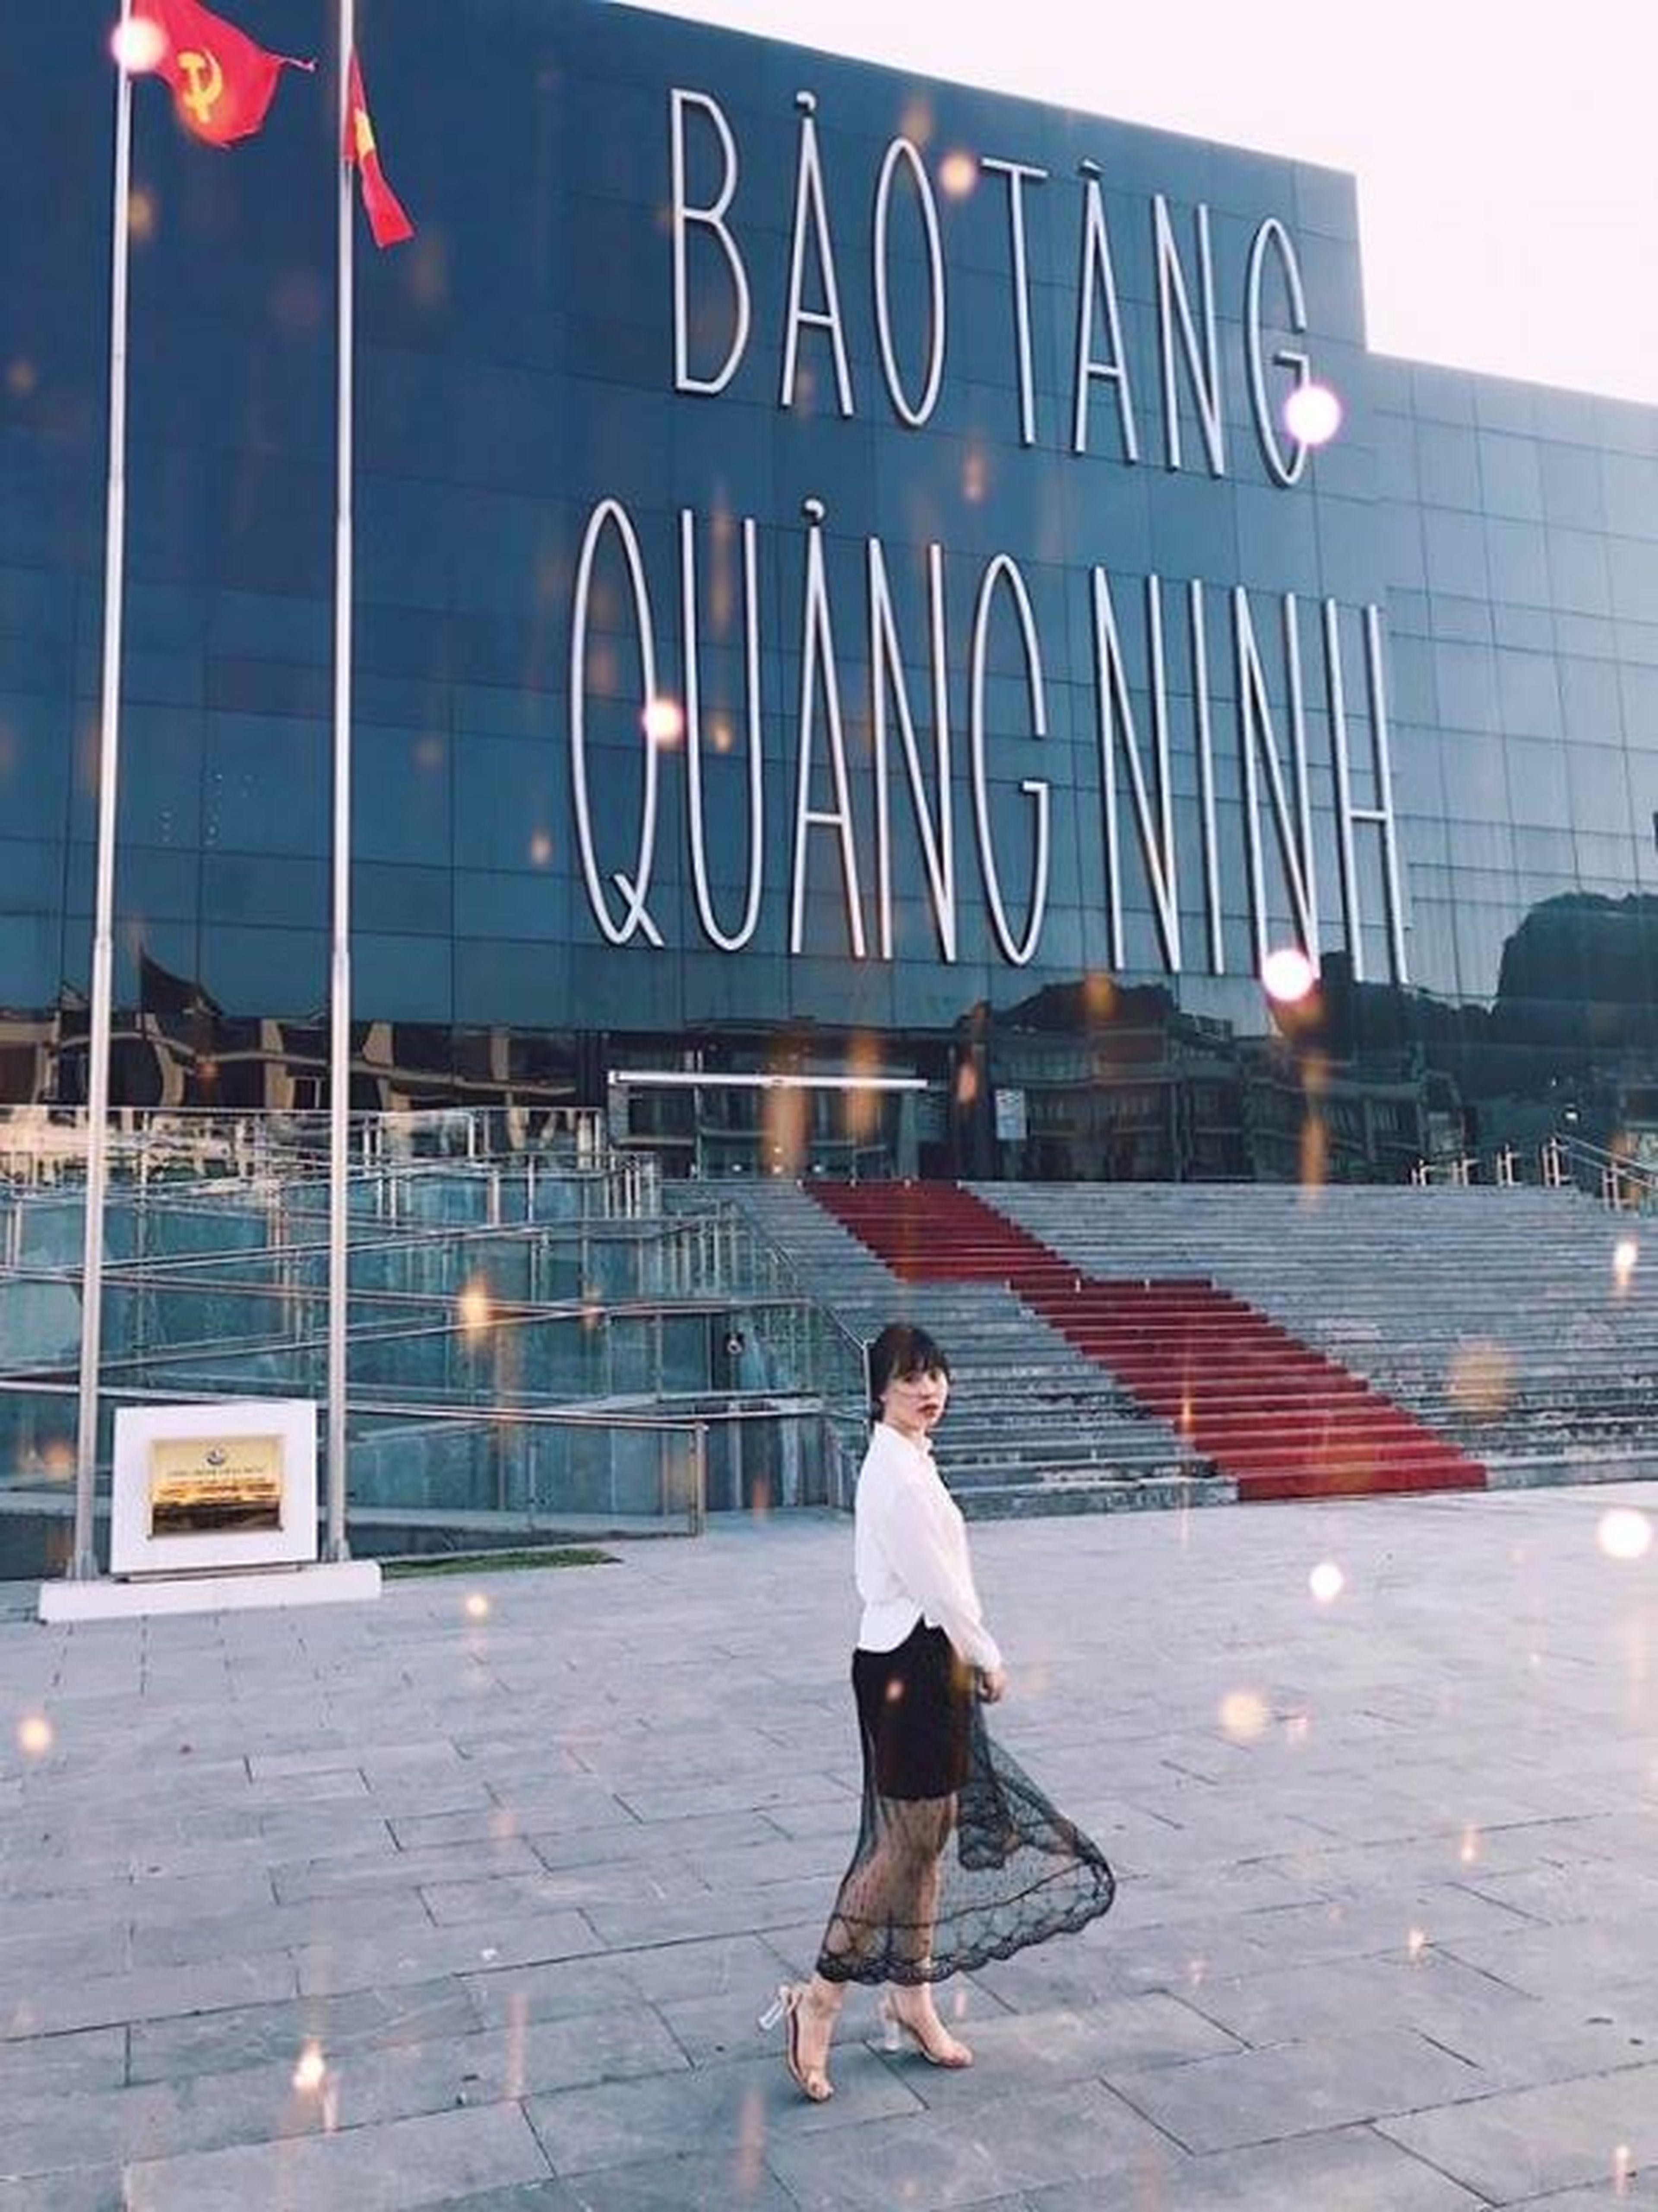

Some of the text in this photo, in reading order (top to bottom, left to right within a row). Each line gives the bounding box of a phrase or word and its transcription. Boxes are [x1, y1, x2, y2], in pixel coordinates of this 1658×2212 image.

[671, 89, 1311, 486] BẢO TÀNG
[571, 498, 1408, 983] QUẢNG NINH
